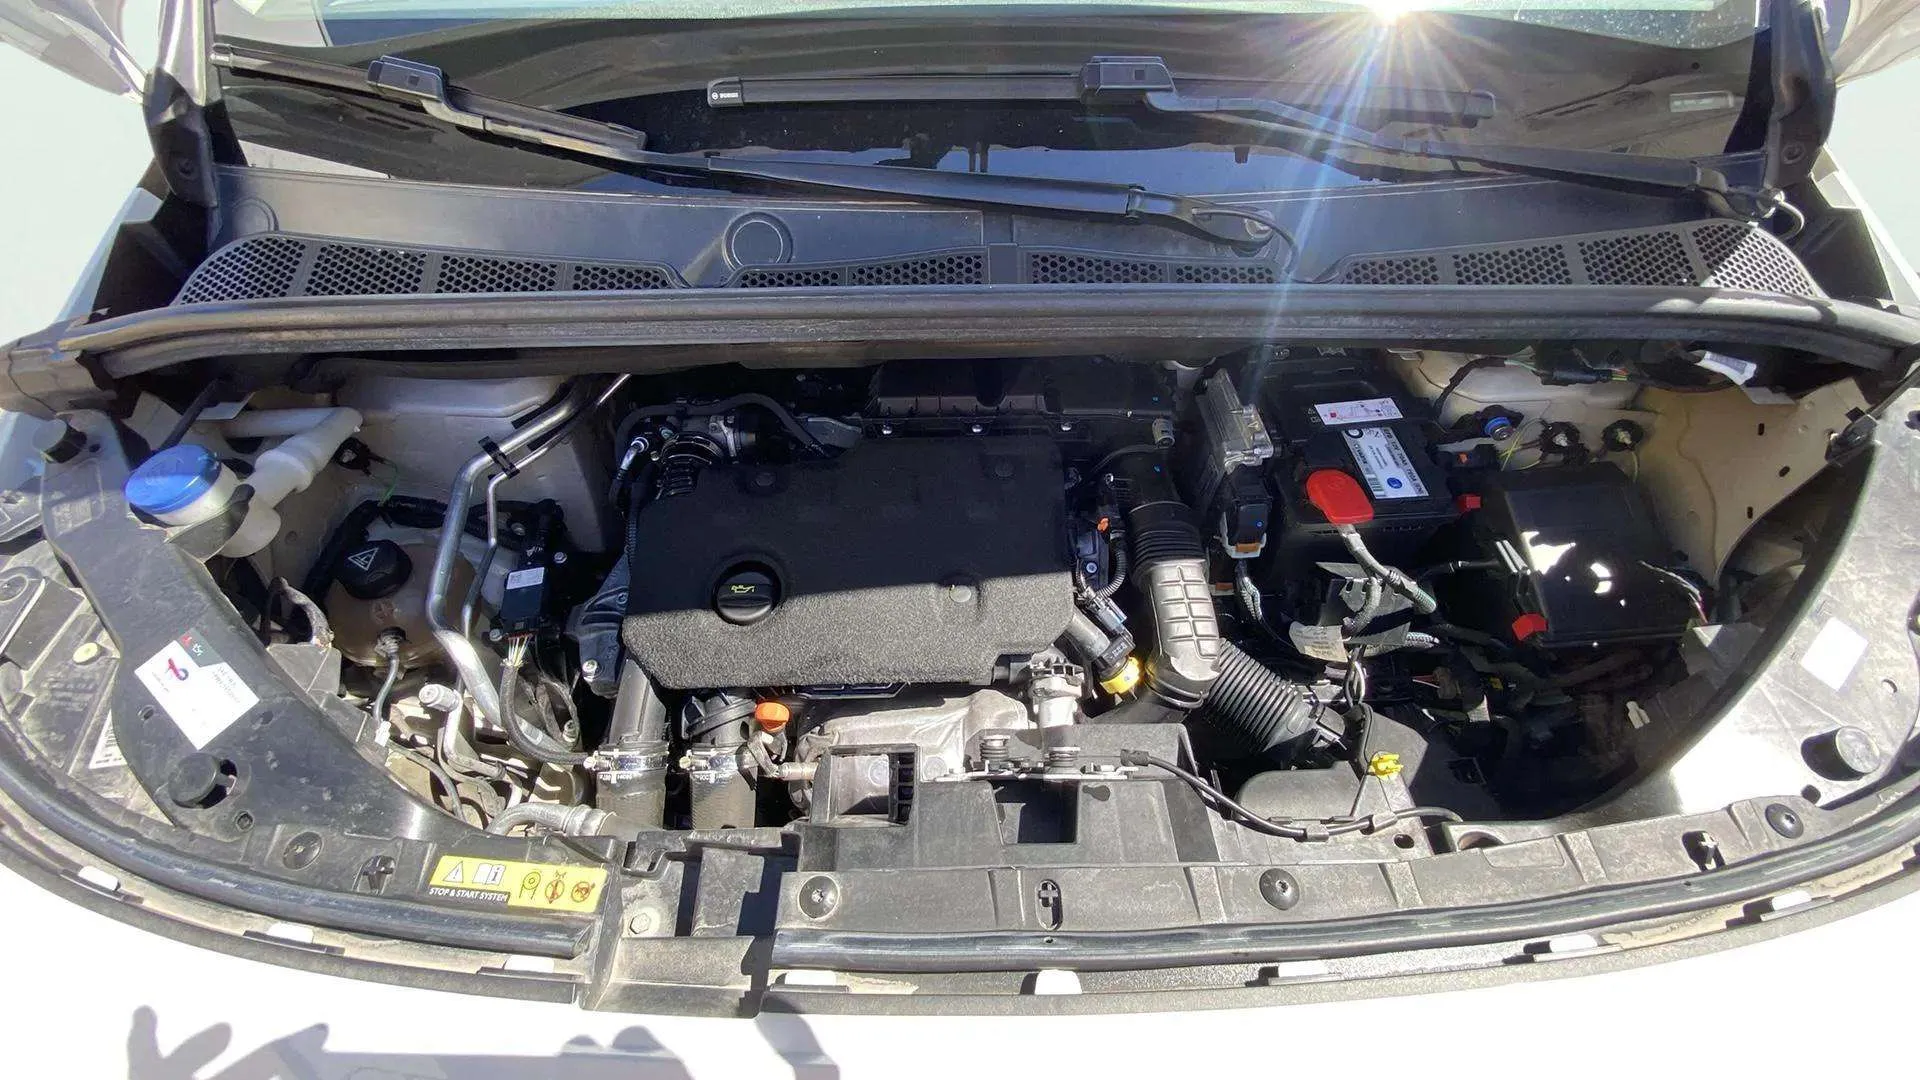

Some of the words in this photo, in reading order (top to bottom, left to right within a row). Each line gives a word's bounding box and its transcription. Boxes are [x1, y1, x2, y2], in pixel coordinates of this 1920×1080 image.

[429, 888, 449, 896] STOP
[449, 889, 455, 897] &
[456, 890, 480, 899] START
[480, 892, 508, 902] SYSTEM
